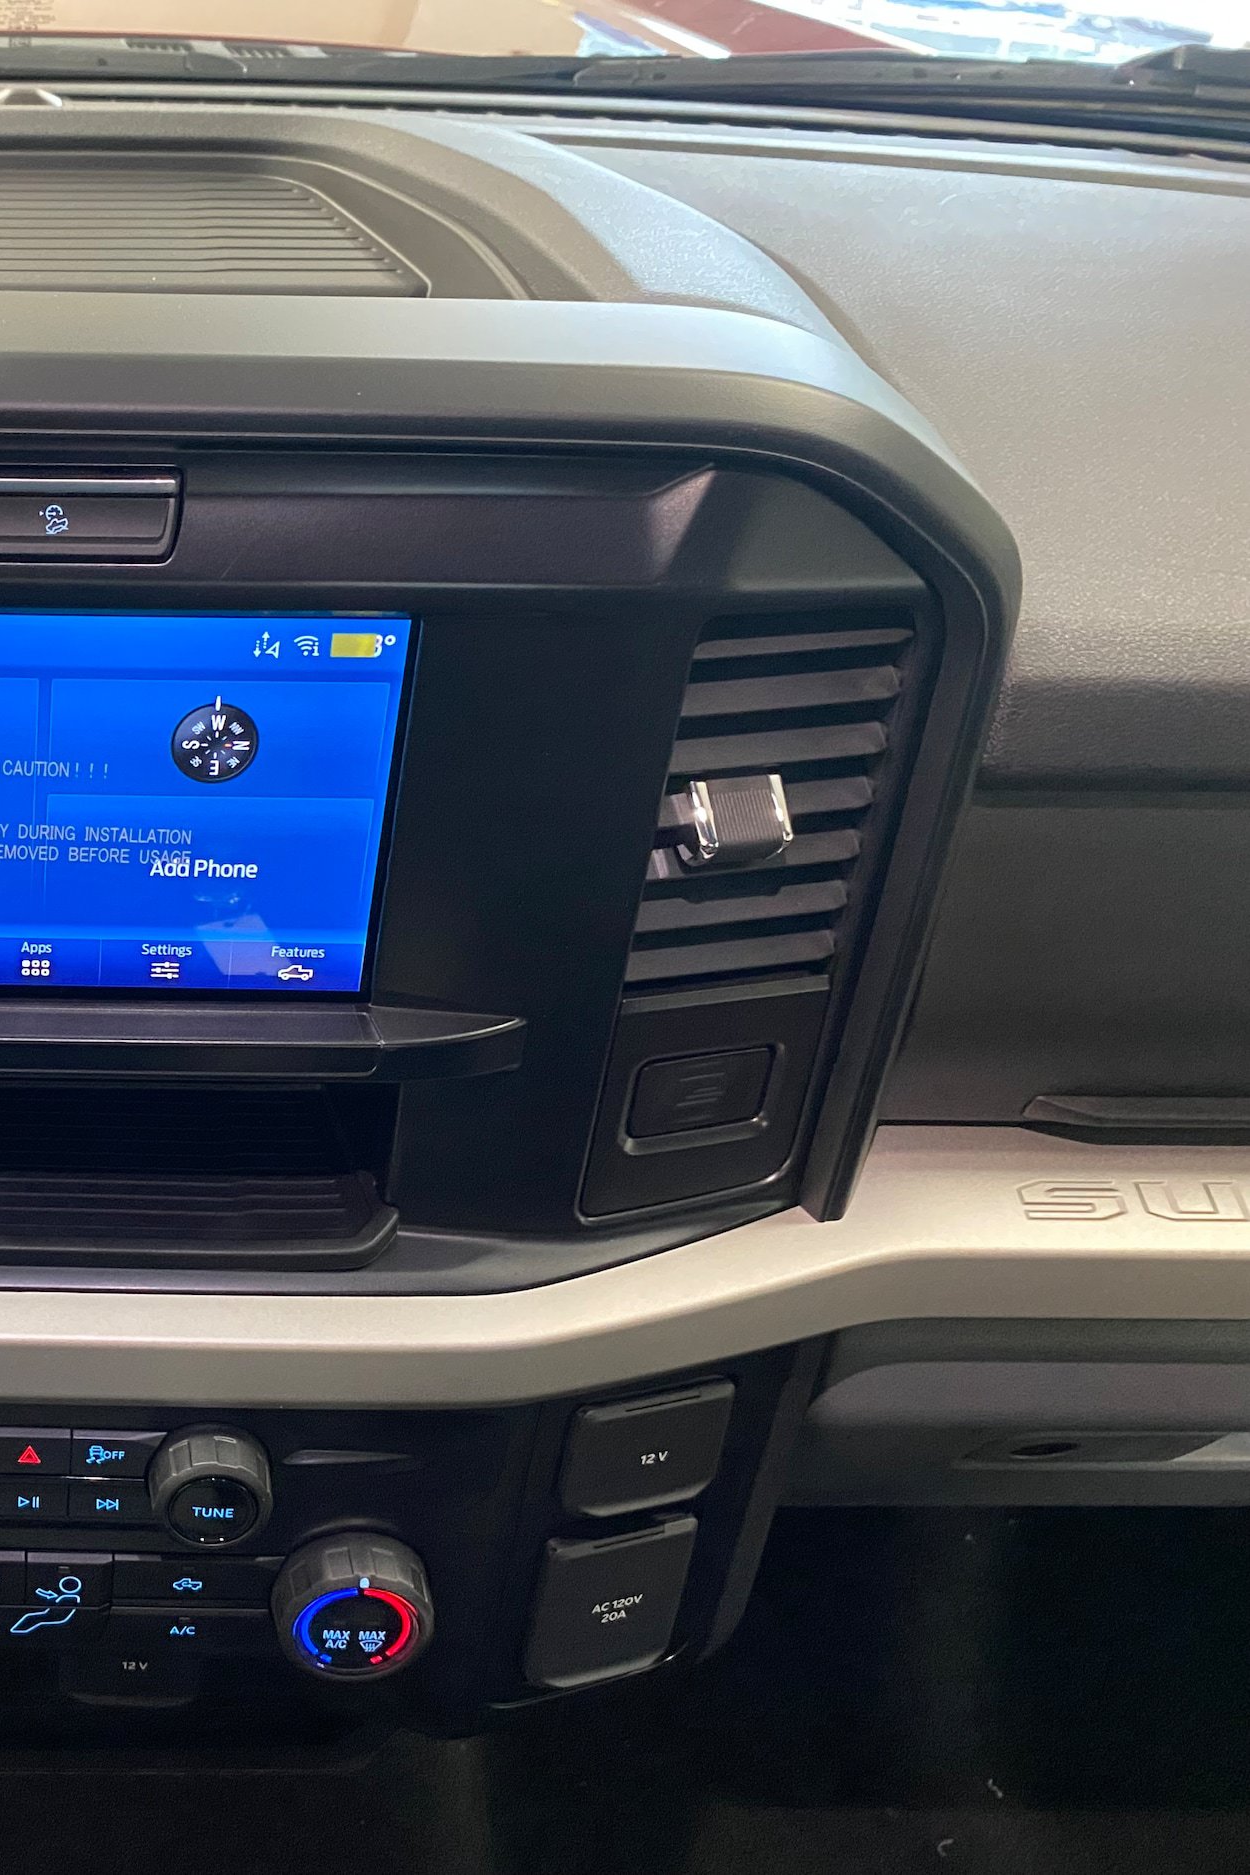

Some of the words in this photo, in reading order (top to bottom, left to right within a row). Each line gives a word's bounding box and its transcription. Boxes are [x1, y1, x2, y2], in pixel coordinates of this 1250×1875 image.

[211, 714, 227, 731] W
[181, 740, 200, 750] S
[232, 740, 250, 751] N
[209, 760, 219, 776] E
[18, 824, 76, 841] DURING
[84, 827, 192, 844] INSTALLATION
[68, 847, 130, 864] BEFORE
[139, 849, 192, 865] USAGE
[150, 858, 190, 877] Add
[193, 859, 258, 879] Phone
[21, 941, 52, 955] Apps
[141, 943, 192, 957] Settings
[271, 945, 325, 959] Features
[104, 1450, 125, 1460] OFF
[640, 1453, 656, 1465] 12
[658, 1451, 668, 1462] V
[192, 1507, 235, 1519] TUNE
[591, 1602, 610, 1614] AC
[611, 1594, 643, 1610] 120V
[601, 1609, 627, 1624] 20A
[170, 1626, 196, 1636] A/C
[323, 1630, 350, 1641] MAX
[358, 1630, 386, 1641] MAX
[325, 1639, 347, 1650] A/C
[122, 1661, 137, 1670] 12
[139, 1661, 148, 1670] V
